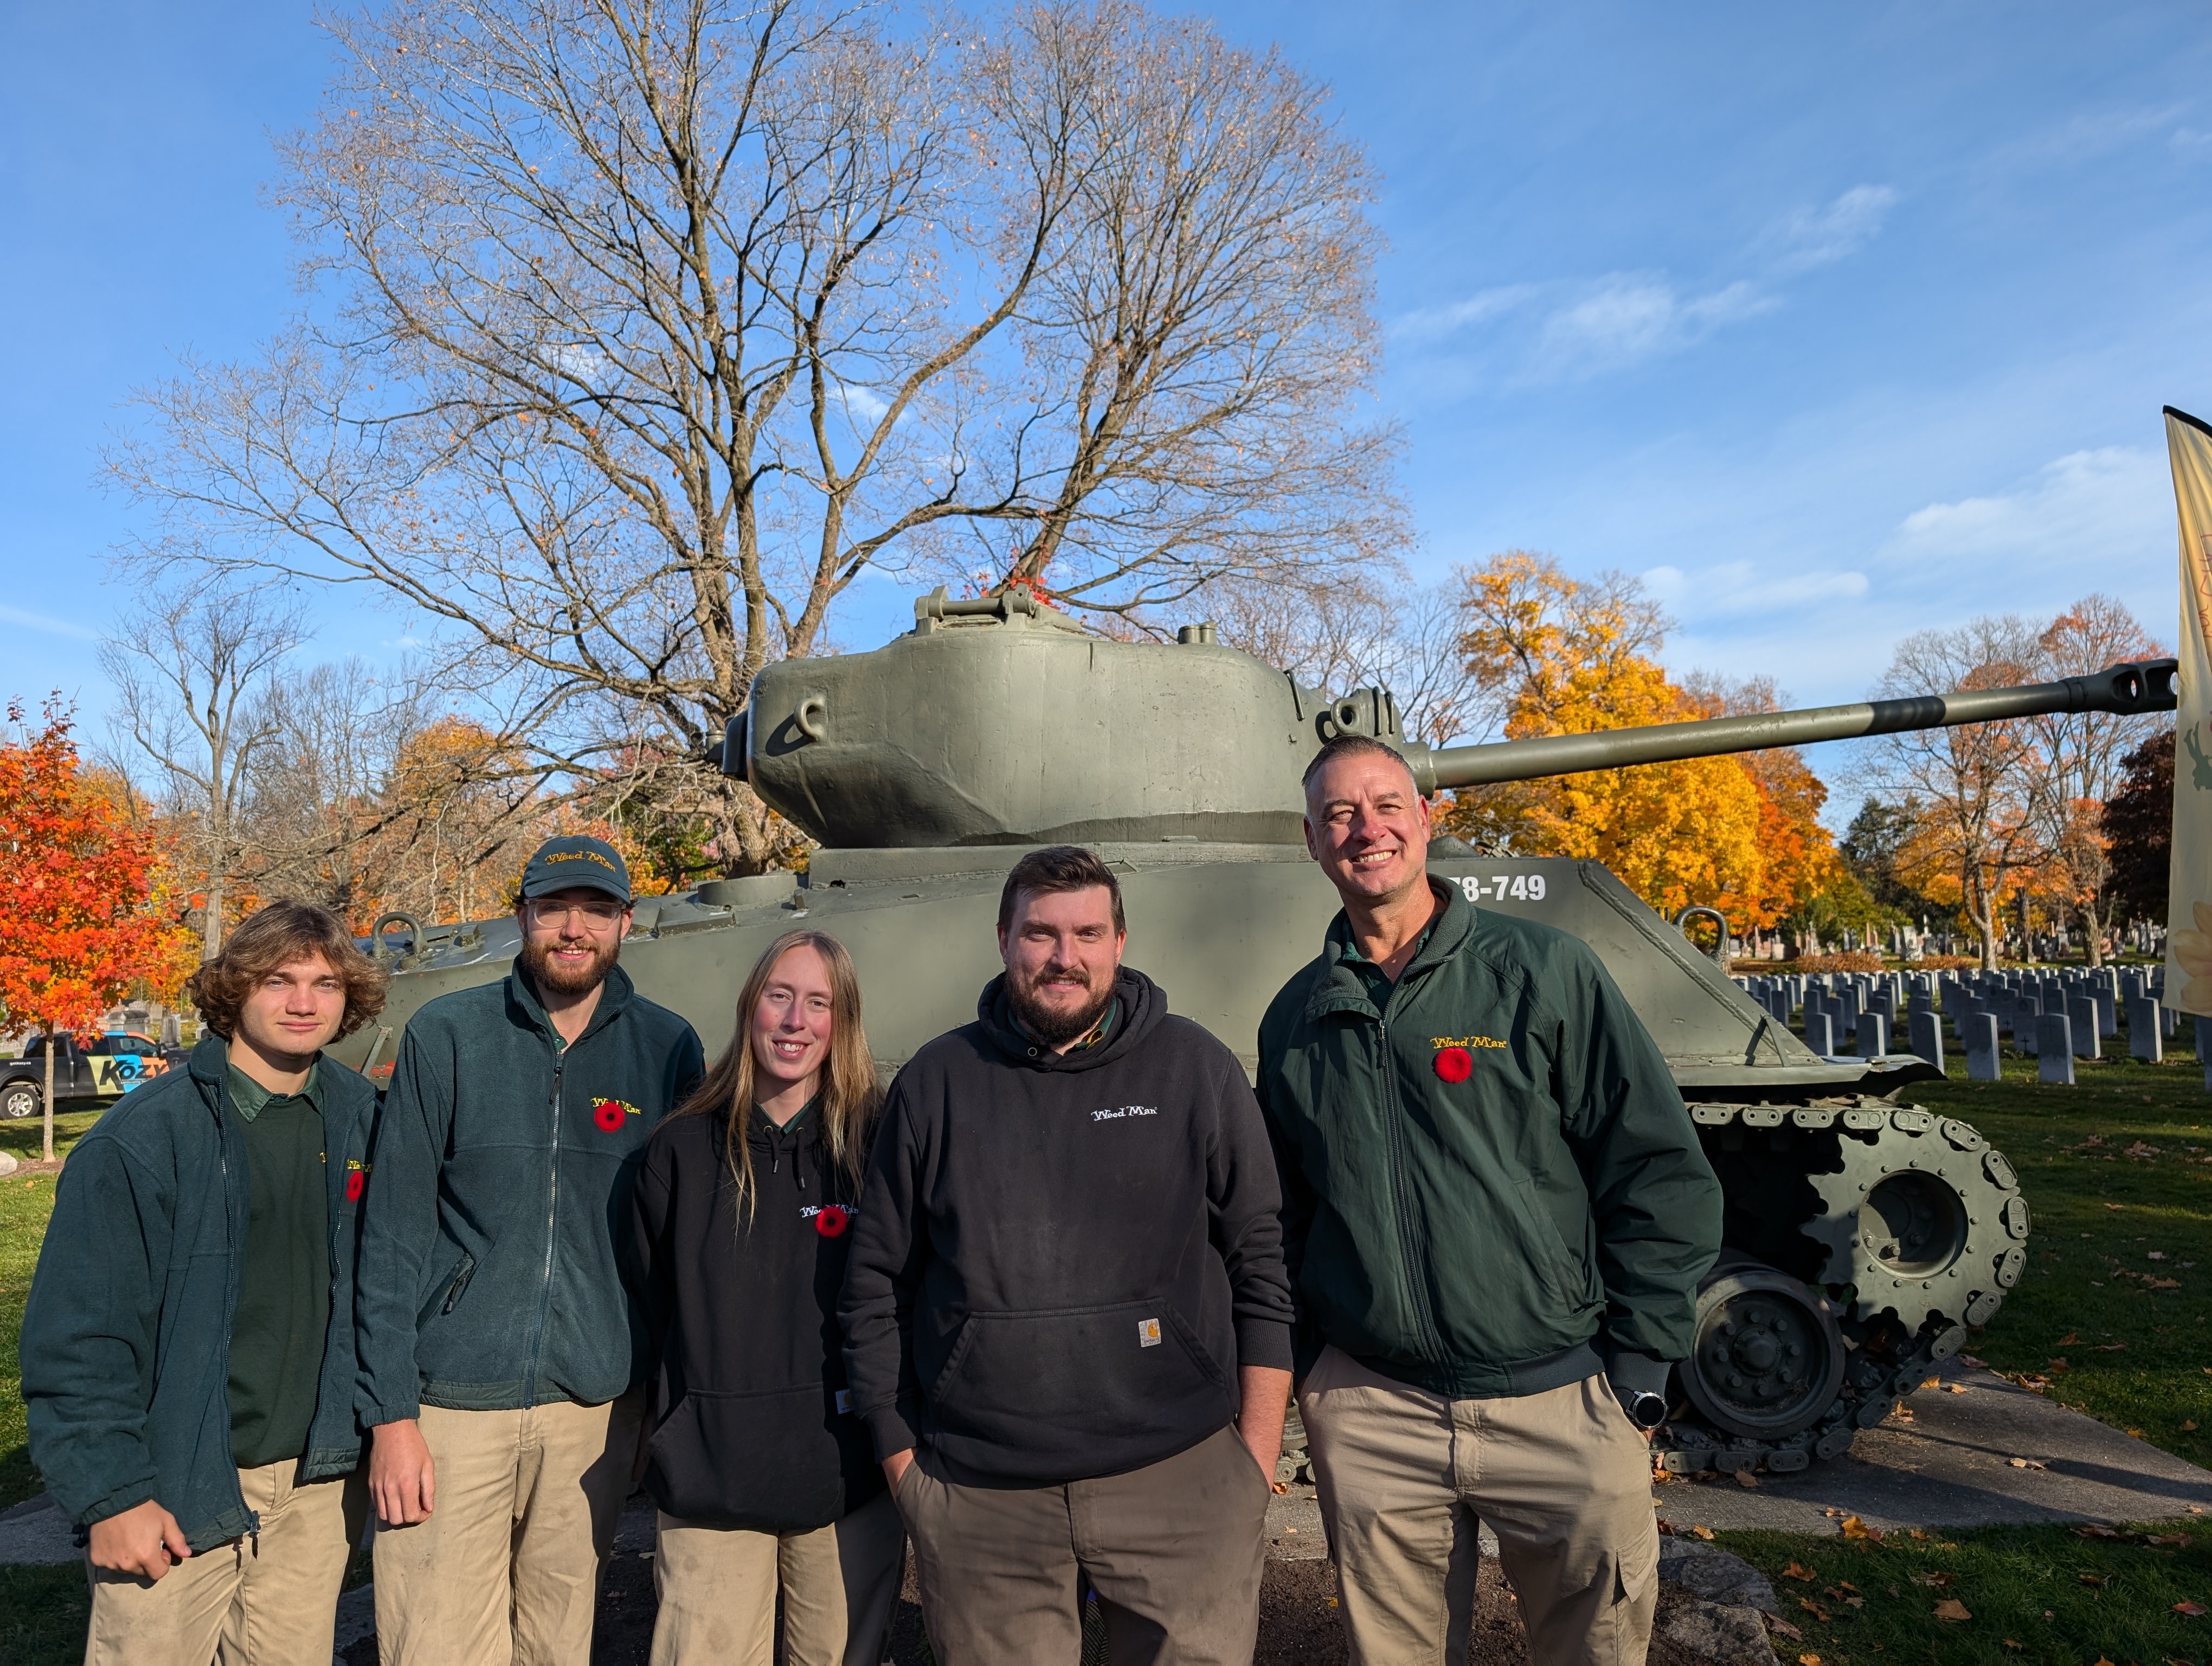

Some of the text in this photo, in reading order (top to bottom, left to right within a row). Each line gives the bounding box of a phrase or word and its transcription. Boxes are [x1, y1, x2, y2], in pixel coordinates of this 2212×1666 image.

[544, 850, 617, 873] Weed Man
[1430, 1036, 1469, 1049] Weed
[1090, 1107, 1127, 1122] Weed
